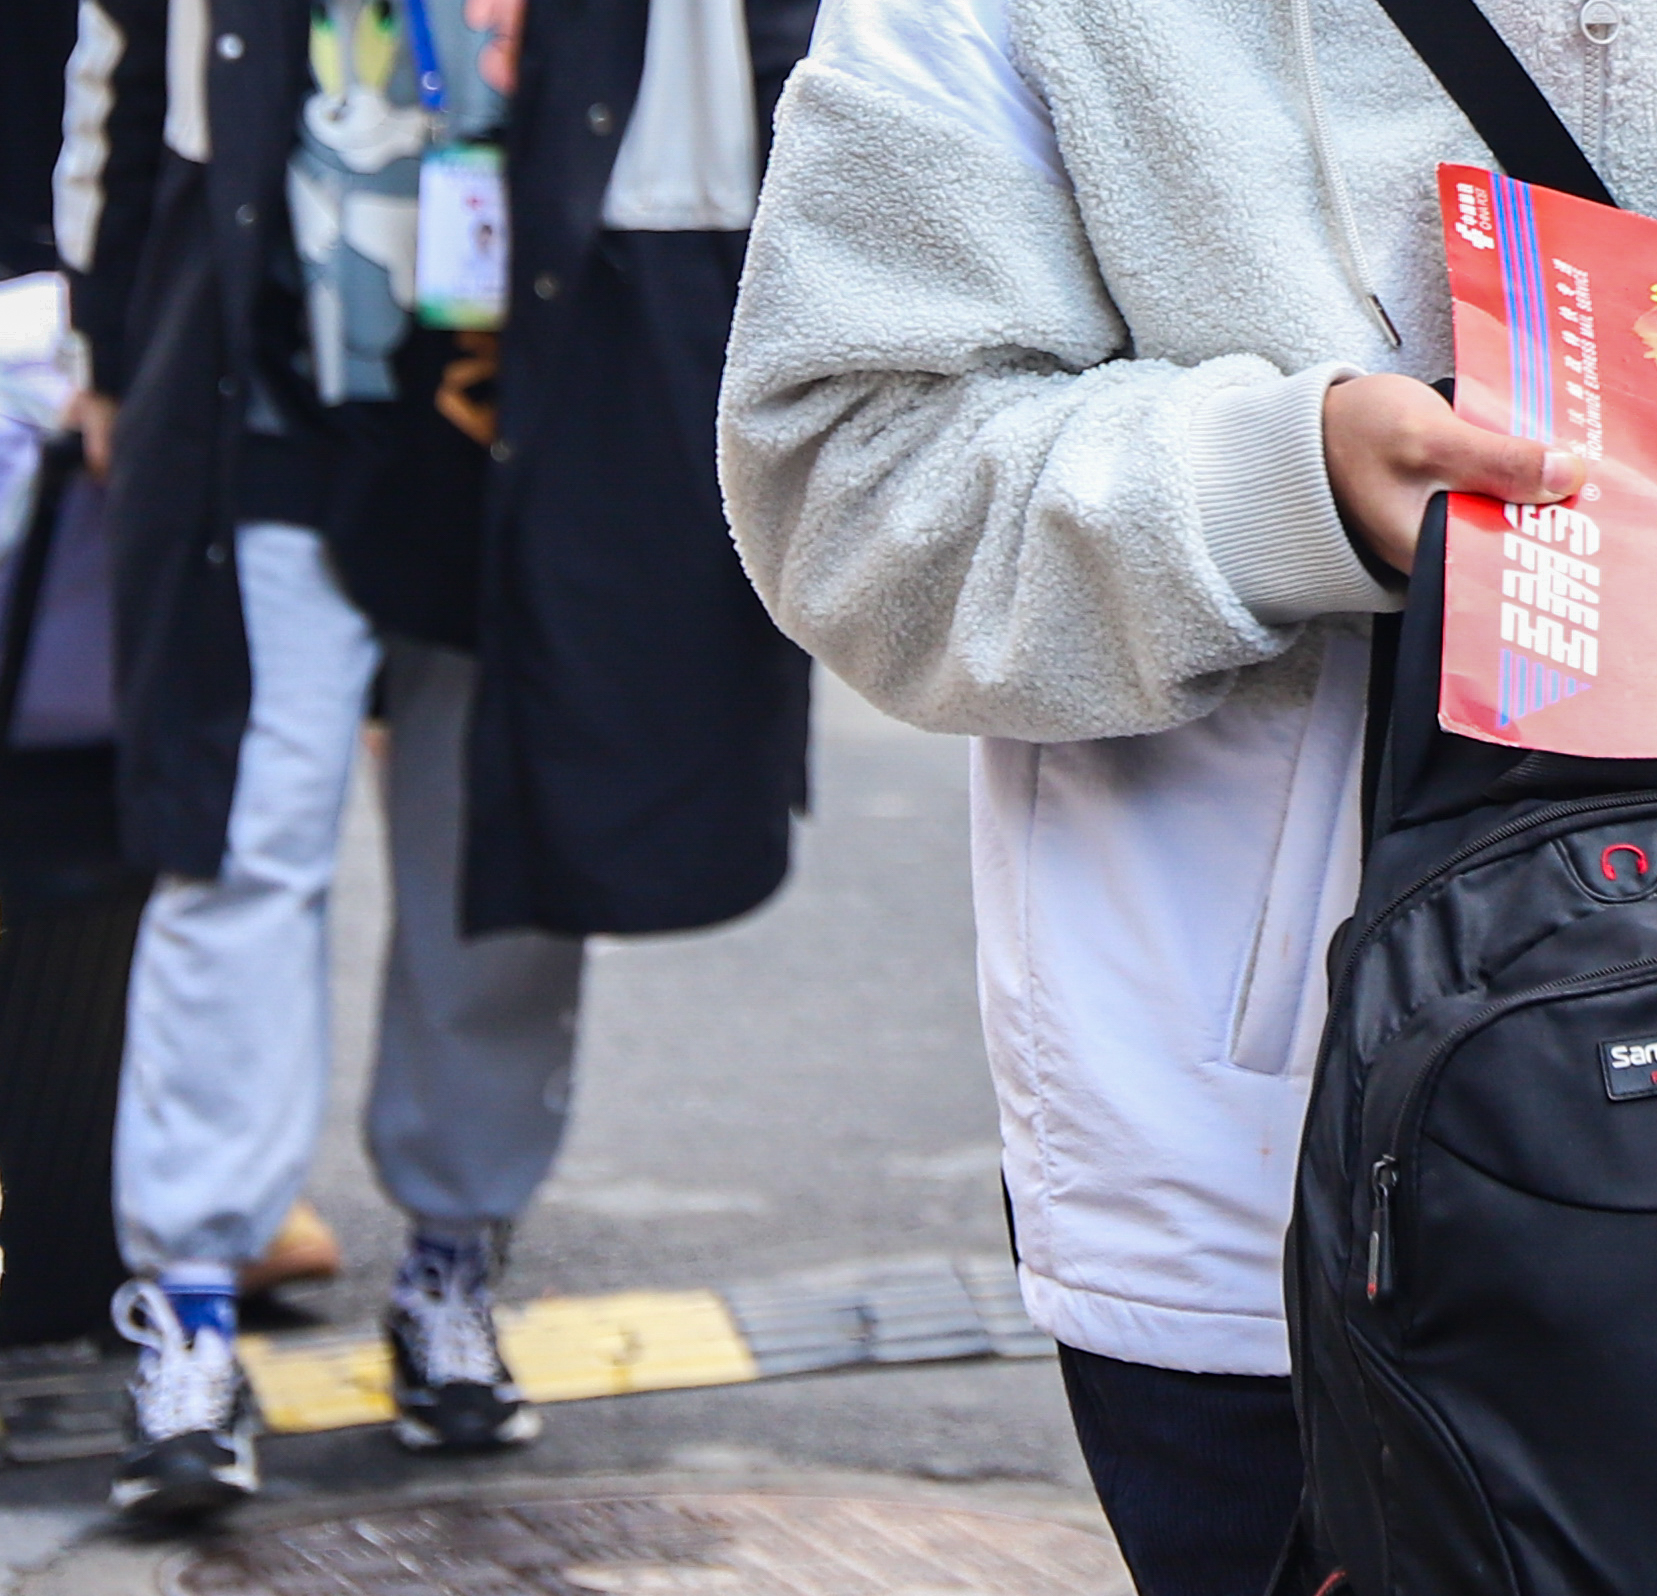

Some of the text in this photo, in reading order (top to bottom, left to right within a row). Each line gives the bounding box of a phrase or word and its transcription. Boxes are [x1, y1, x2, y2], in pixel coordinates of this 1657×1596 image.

[1570, 268, 1604, 461] WORLDWIDE EXPRESS MAIL SERVICE
